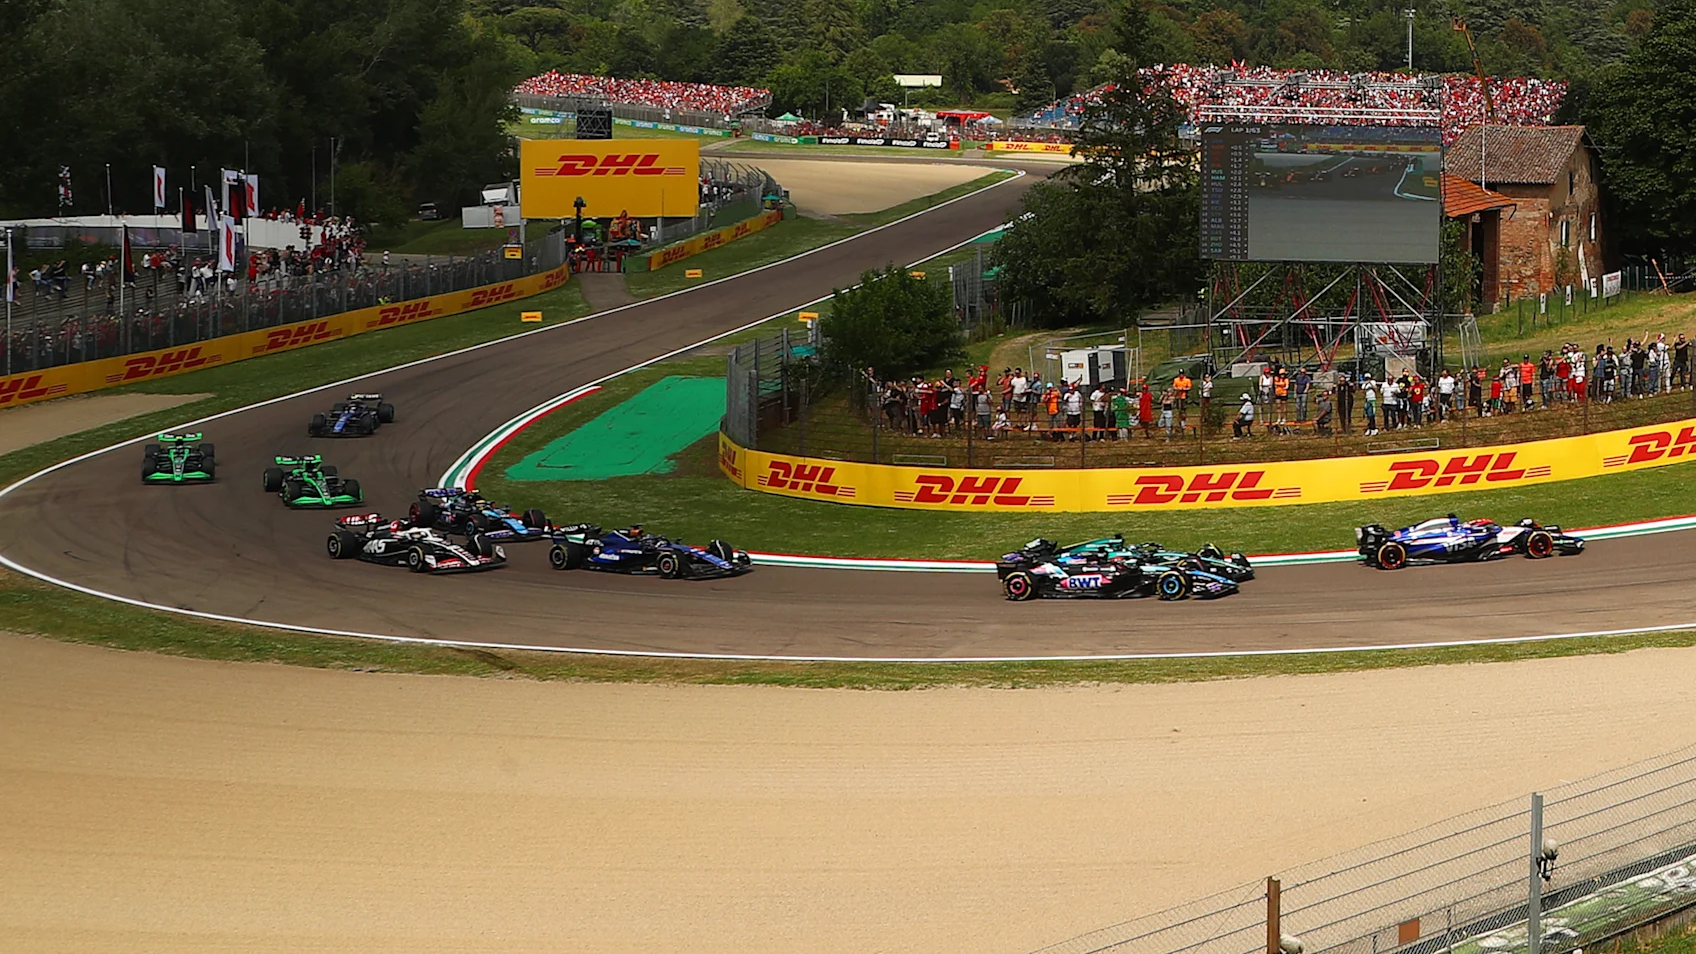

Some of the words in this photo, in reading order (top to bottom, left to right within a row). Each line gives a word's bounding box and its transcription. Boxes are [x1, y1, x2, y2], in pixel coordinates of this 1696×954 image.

[555, 154, 666, 176] DHL
[470, 283, 516, 307] DHL
[378, 301, 433, 326] DHL
[266, 321, 333, 350] DHL
[123, 346, 208, 380] DHL
[766, 460, 839, 496] DHL
[1387, 451, 1526, 490] DHL
[913, 474, 1031, 507] DHL
[1132, 470, 1276, 504] DHL
[1067, 574, 1102, 589] BWT
